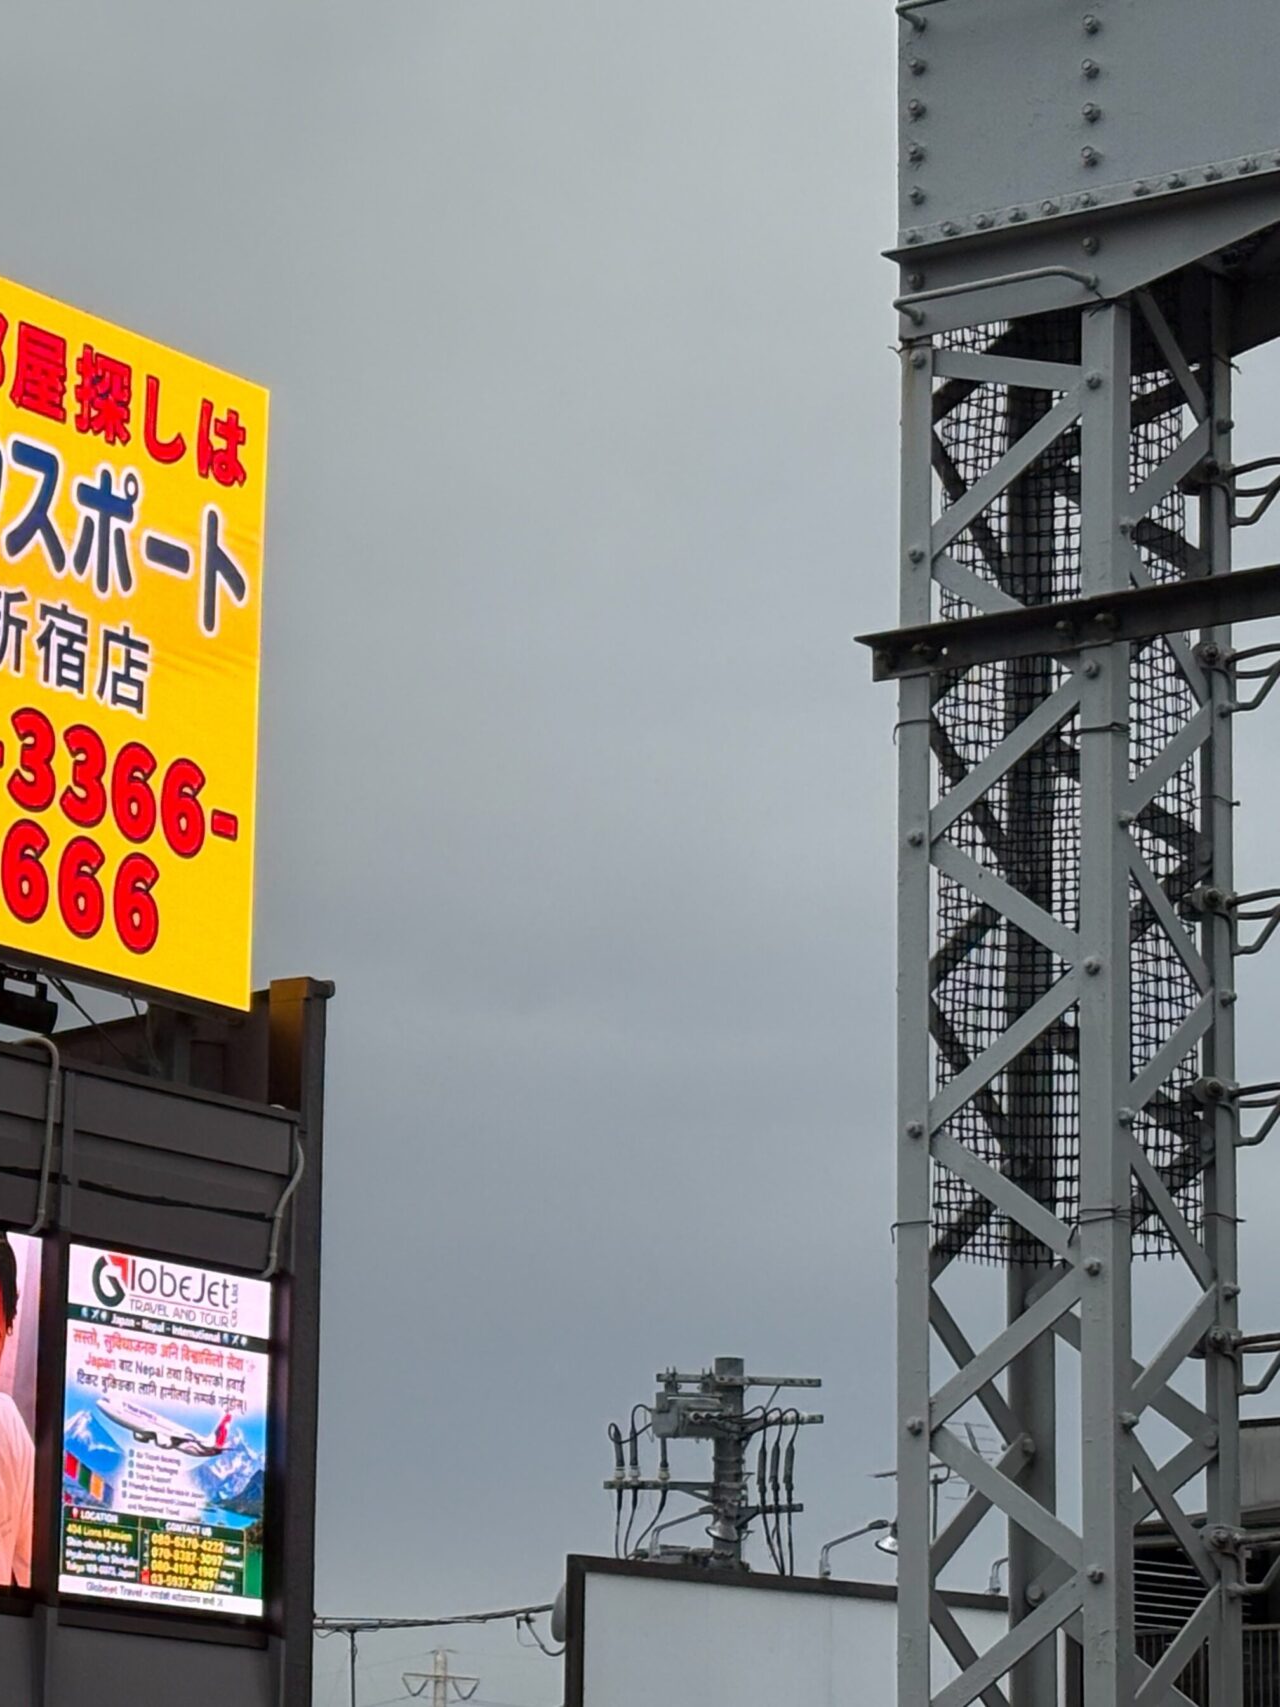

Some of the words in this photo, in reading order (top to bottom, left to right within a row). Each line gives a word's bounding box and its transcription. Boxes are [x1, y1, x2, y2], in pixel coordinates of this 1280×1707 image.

[111, 1313, 135, 1328] Japan
[141, 1319, 165, 1333] Nepal
[129, 1299, 169, 1318] TRAVEL
[173, 1309, 196, 1321] AND
[200, 1312, 228, 1327] TOUR
[85, 1352, 116, 1370] Japan
[136, 1360, 163, 1378] Nepal
[80, 1510, 118, 1524] LOCATION
[165, 1522, 200, 1536] CONTACT
